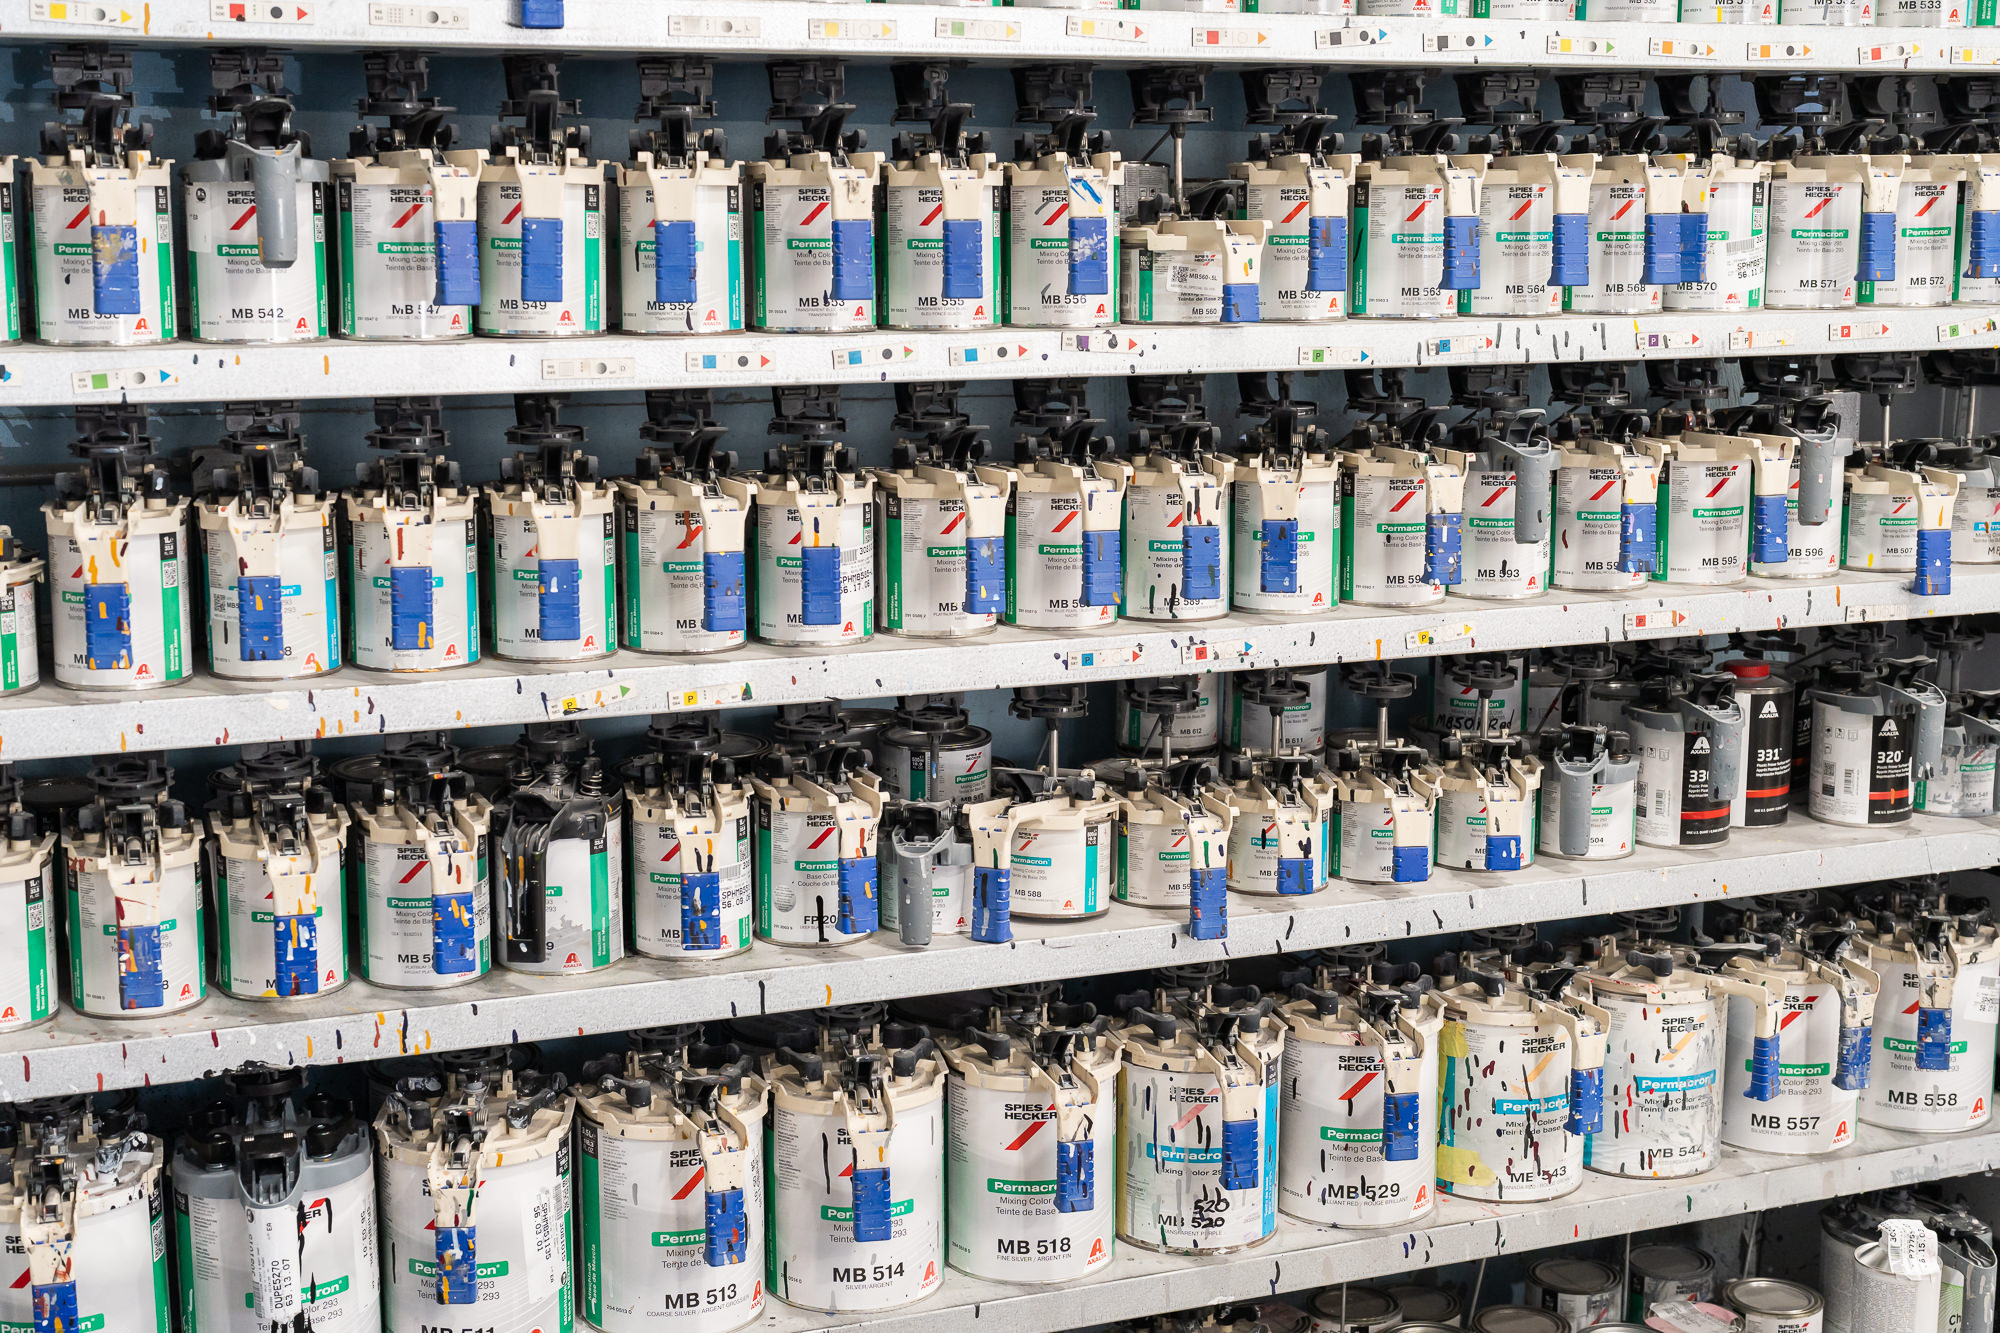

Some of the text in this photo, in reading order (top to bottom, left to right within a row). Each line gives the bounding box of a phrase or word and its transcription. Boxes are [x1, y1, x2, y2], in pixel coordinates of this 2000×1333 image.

[1898, 0, 1941, 9] MB 533
[1906, 228, 1948, 236] Permacron
[1800, 279, 1837, 288] MB 571
[1910, 276, 1944, 285] MB 572
[1506, 285, 1544, 294] MB 564
[1605, 283, 1645, 293] MB 568
[1676, 282, 1717, 290] MB 570
[1278, 290, 1321, 300] MB 562
[1402, 288, 1440, 297] MB 563
[799, 298, 819, 307] MB
[918, 297, 937, 306] MB
[1041, 295, 1086, 304] MB 556
[392, 304, 413, 314] MB
[500, 299, 519, 310] MB
[232, 308, 284, 319] MB 542
[1698, 508, 1741, 516] Permacron
[1805, 548, 1823, 556] 596
[1585, 561, 1620, 570] MB 59
[1702, 557, 1737, 566] MB 595
[1477, 569, 1495, 578] MB
[1387, 576, 1421, 584] MB 59
[1049, 600, 1068, 608] MB
[676, 619, 697, 629] MB
[1759, 711, 1779, 719] AXALTA
[1757, 750, 1779, 761] 331
[1878, 751, 1902, 762] 320
[1028, 890, 1041, 898] 588
[804, 915, 818, 924] FP
[662, 929, 680, 938] MB
[398, 953, 419, 963] MB
[1662, 1016, 1694, 1026] SPIES
[1522, 1037, 1556, 1046] SPIES
[1522, 1043, 1565, 1054] HECKER
[1641, 1076, 1713, 1090] Permacron
[1805, 1078, 1819, 1086] 293
[1169, 1095, 1218, 1103] HECKER
[1889, 1089, 1958, 1106] MB 558
[1005, 1104, 1043, 1112] SPIES
[1005, 1112, 1057, 1120] HECKER
[1751, 1114, 1821, 1130] MB 557
[670, 1150, 699, 1159] SPIE
[1648, 1145, 1703, 1158] MB 544
[670, 1158, 703, 1168] HECK
[1328, 1183, 1401, 1201] MB 529
[1000, 1197, 1052, 1206] Mixing Color
[1193, 1197, 1230, 1214] 520
[996, 1207, 1056, 1216] Teinte de Base
[891, 1219, 903, 1228] 293
[1191, 1215, 1225, 1228] 520
[893, 1229, 907, 1238] 293
[996, 1238, 1071, 1254] MB 518
[667, 1248, 694, 1258] Mixing
[1036, 1254, 1061, 1262] ARGENT
[1086, 1252, 1108, 1266] AXALTA
[662, 1260, 686, 1268] Teinte
[833, 1262, 904, 1283] MB 514
[272, 1260, 283, 1309] DUPE5270
[282, 1258, 293, 1306] 63.13.07
[845, 1281, 893, 1290] SILVER/ARGENT
[921, 1277, 939, 1290] AXALTA
[482, 1292, 500, 1301] 293
[665, 1284, 736, 1310] MB 513
[702, 1304, 724, 1314] ARGENT
